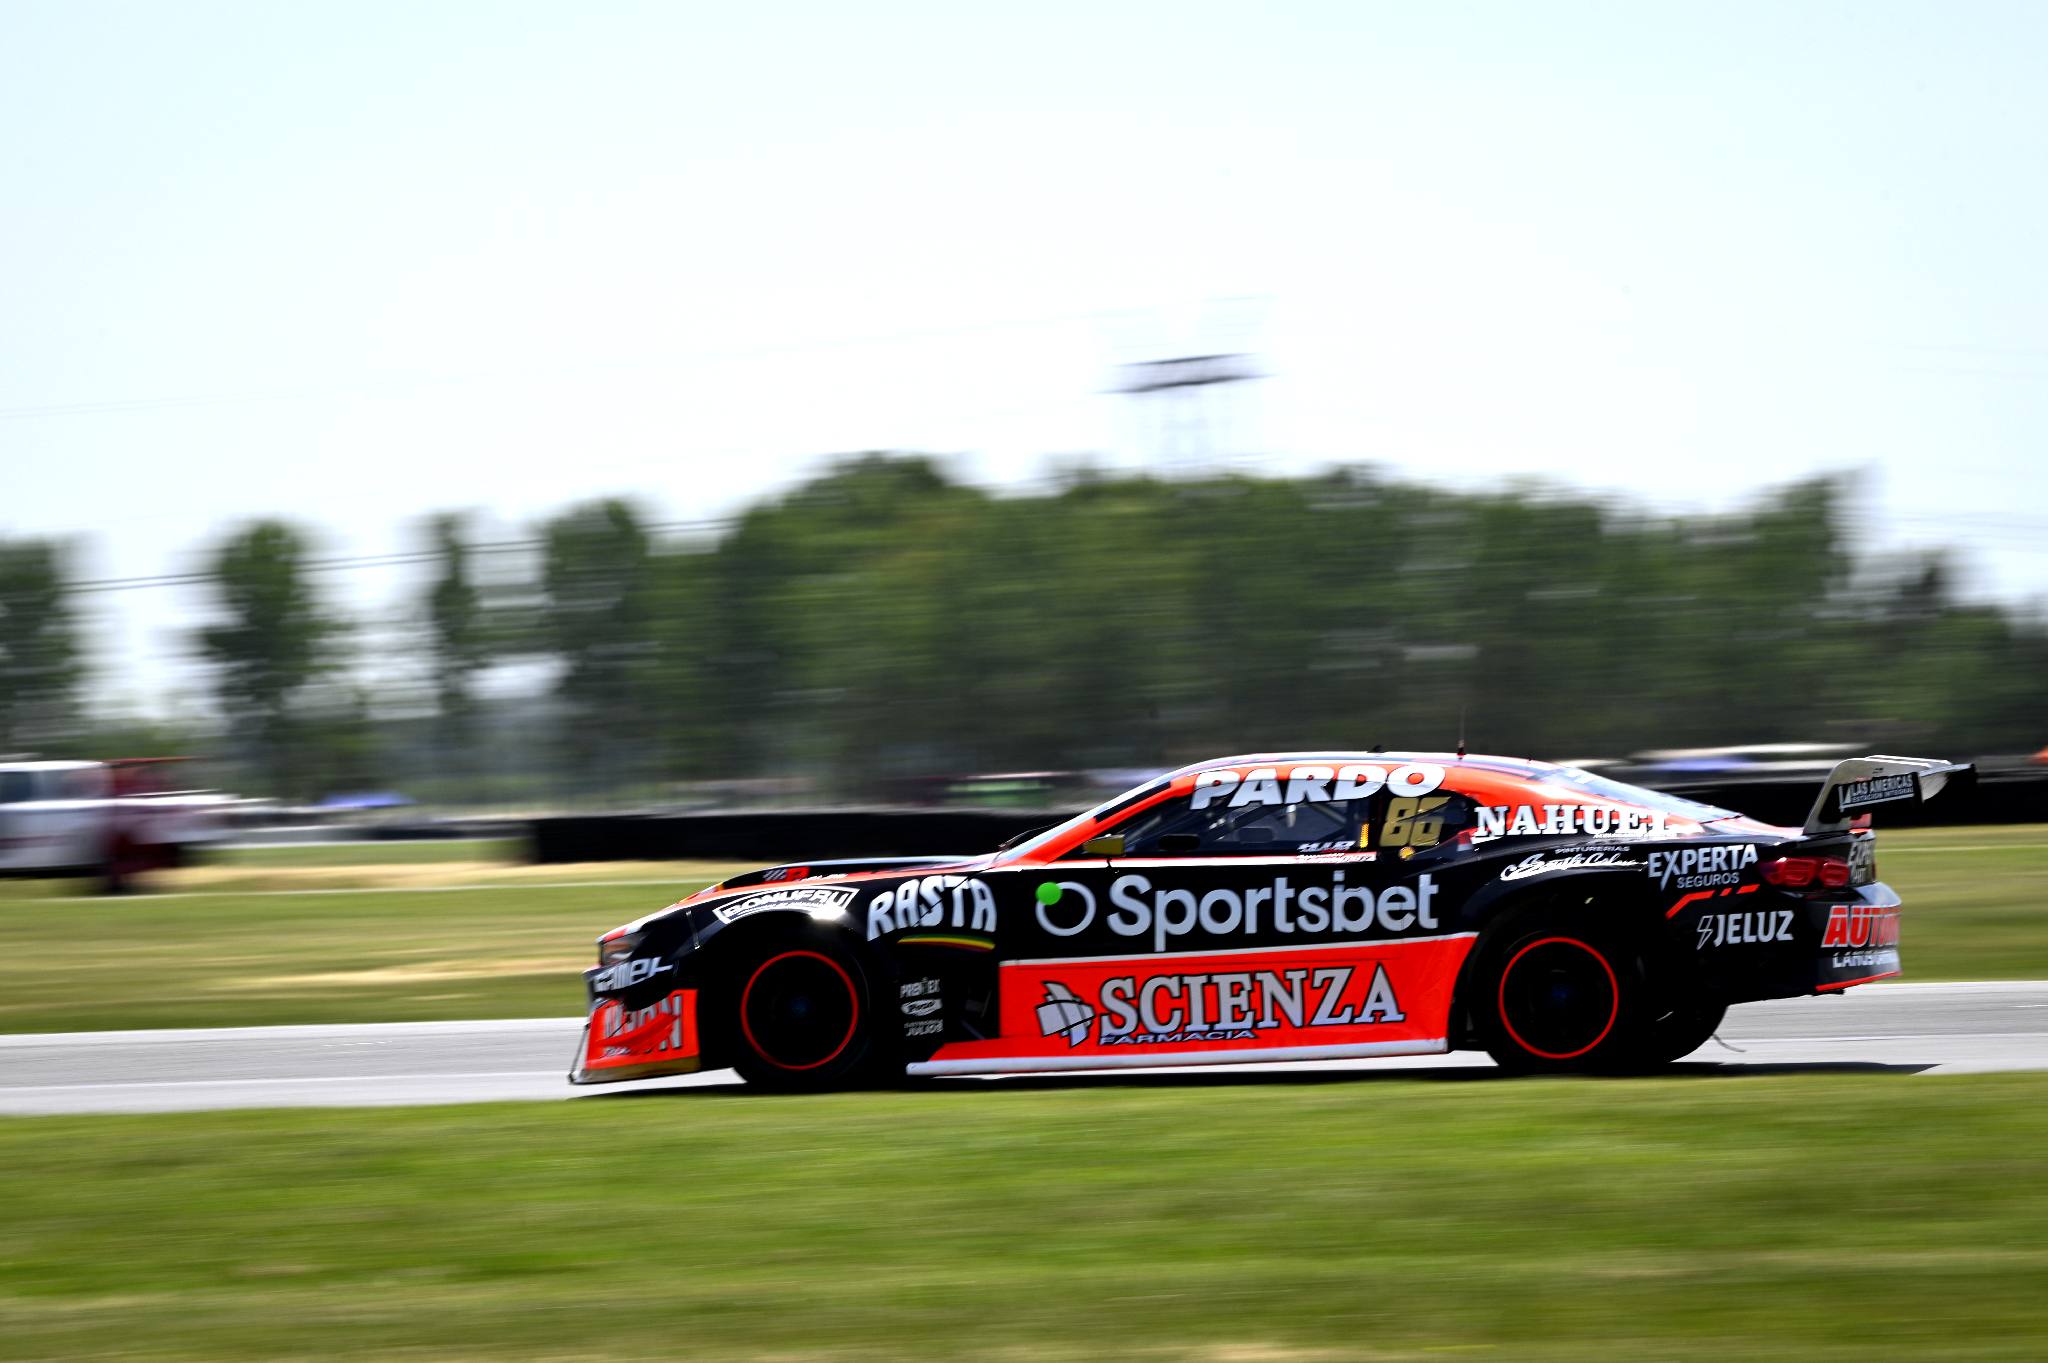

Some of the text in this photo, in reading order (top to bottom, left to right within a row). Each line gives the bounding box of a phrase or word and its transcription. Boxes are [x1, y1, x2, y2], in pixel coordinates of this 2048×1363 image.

[1190, 765, 1446, 810] PARDO
[1850, 774, 1914, 798] LAS AMERICAS
[1380, 797, 1451, 846] 86
[1472, 805, 1675, 837] NAHUEL
[1648, 844, 1758, 892] EXPERTA
[1676, 872, 1740, 889] SEGUROS
[866, 875, 998, 941] RASTA
[1107, 871, 1439, 952] Sportsbet
[1714, 910, 1794, 947] JELUZ
[1099, 963, 1405, 1036] SCIENZA
[1099, 1029, 1258, 1046] FARMACIA
